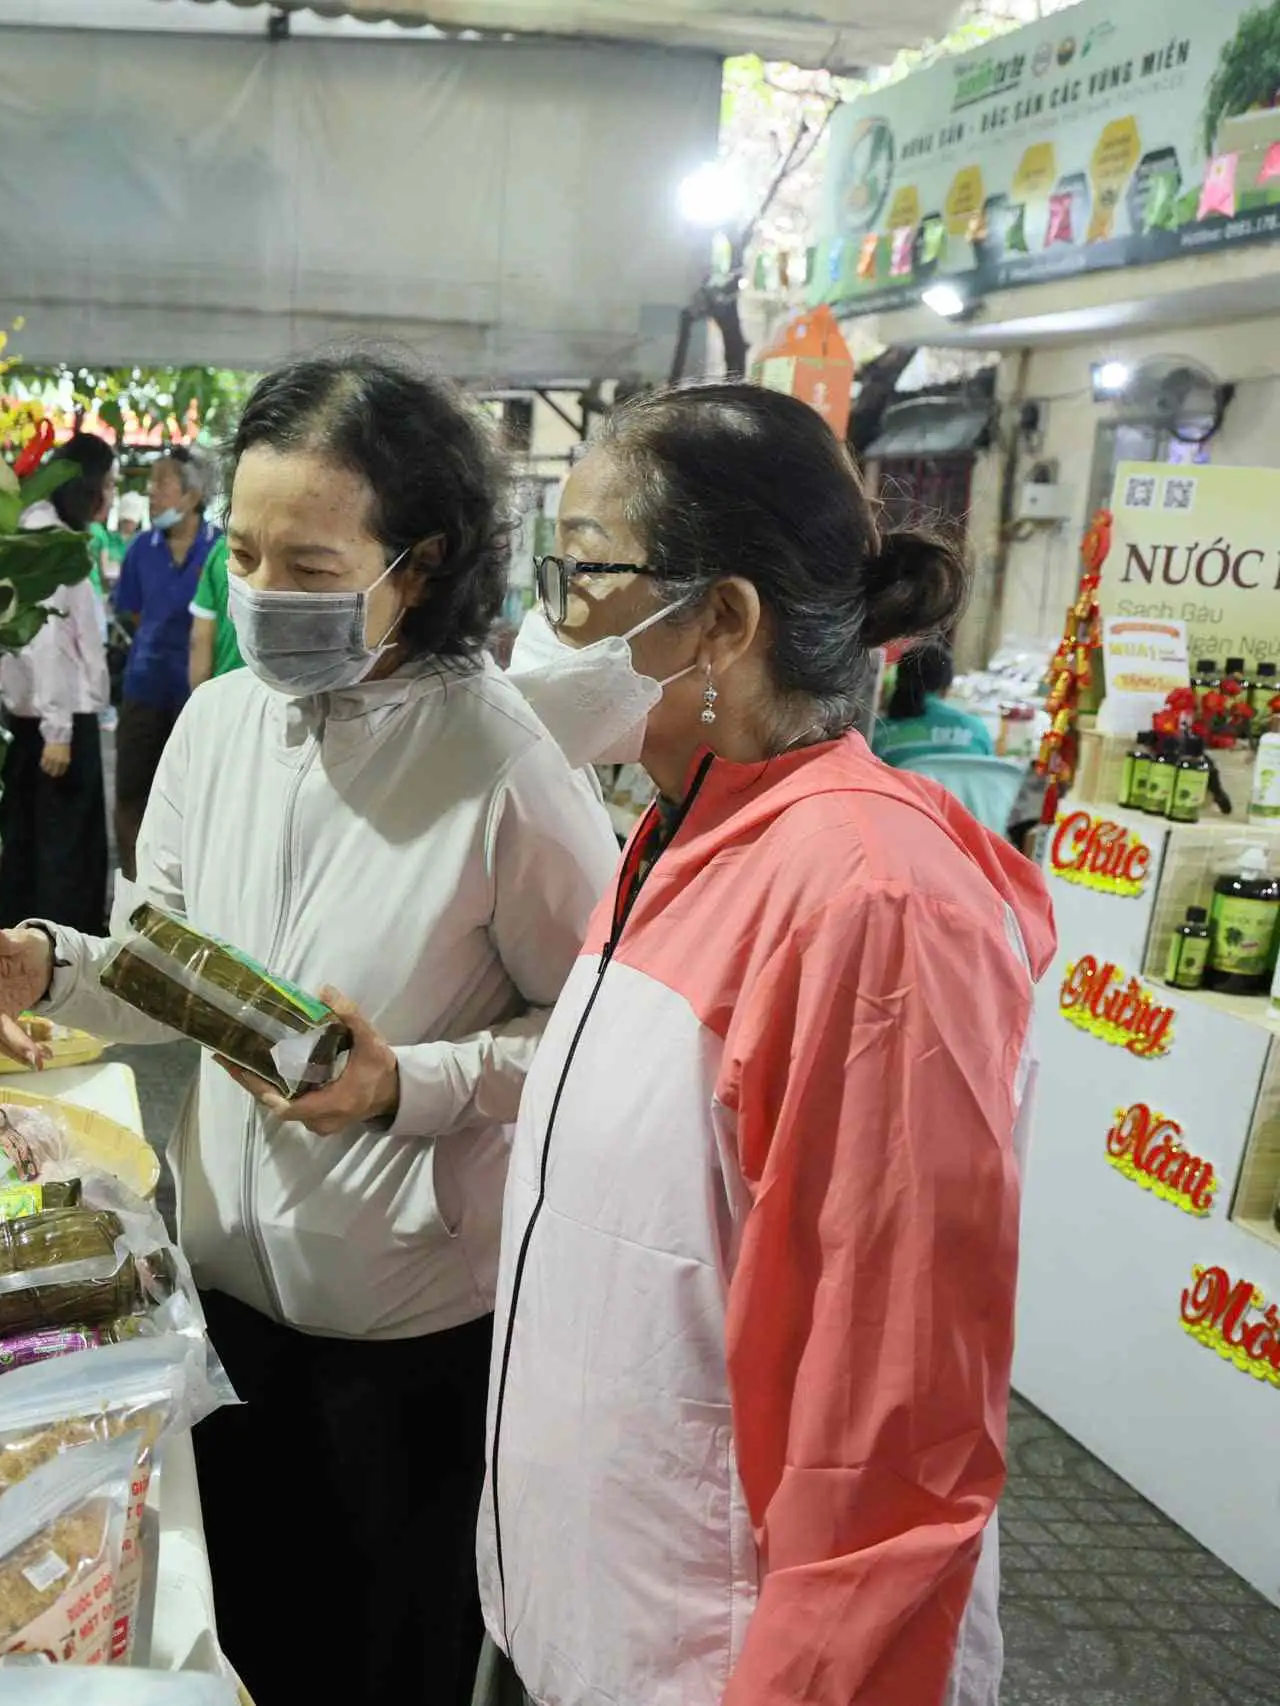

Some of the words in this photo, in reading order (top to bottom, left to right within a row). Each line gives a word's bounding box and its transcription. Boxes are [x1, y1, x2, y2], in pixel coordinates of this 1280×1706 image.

[1119, 536, 1265, 590] NƯỚC
[1051, 811, 1150, 883] Chúc
[1060, 955, 1175, 1057] Mừng
[1107, 1102, 1214, 1210] Năm
